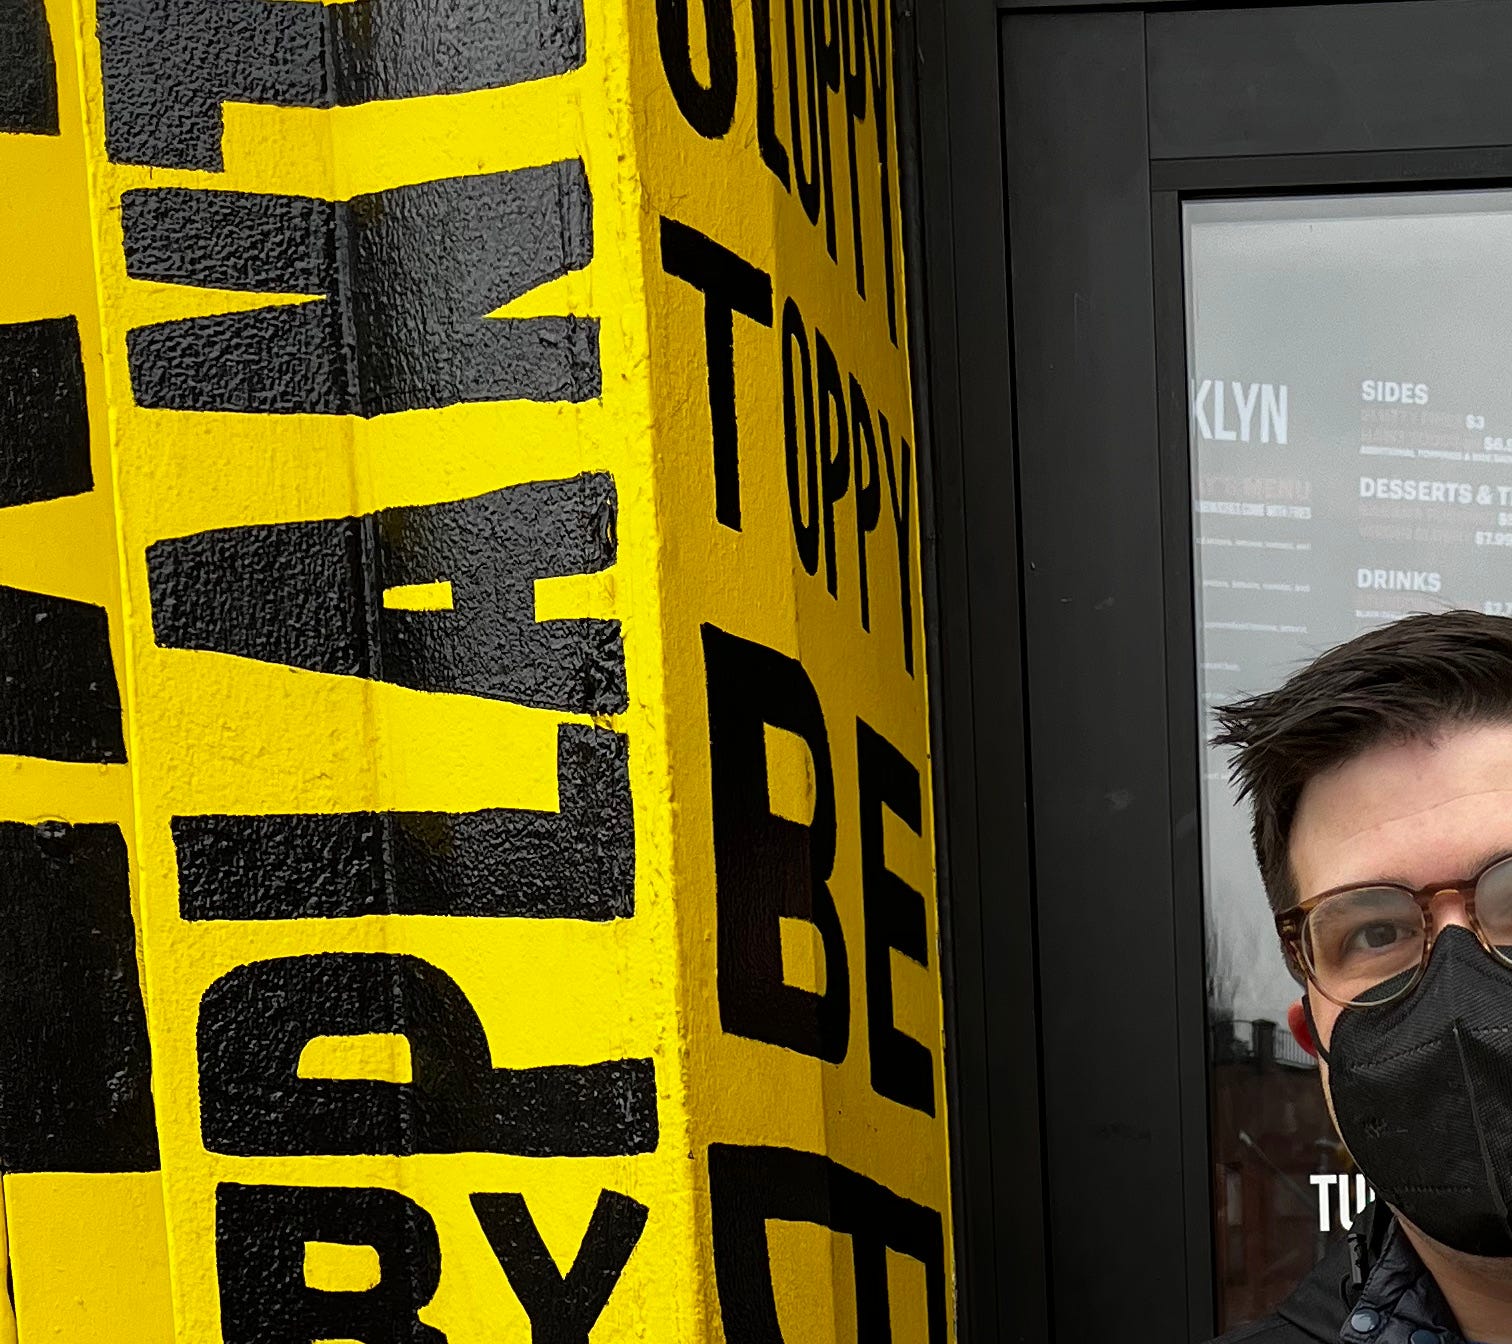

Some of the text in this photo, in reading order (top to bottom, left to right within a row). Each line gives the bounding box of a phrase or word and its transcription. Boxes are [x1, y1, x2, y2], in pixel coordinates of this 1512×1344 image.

[1360, 379, 1430, 405] SIDES
[659, 214, 914, 680] TOPPY
[1359, 476, 1473, 505] DESSERTS
[1475, 484, 1493, 506] &
[1357, 567, 1442, 593] DRINKS
[700, 622, 937, 1118] BE
